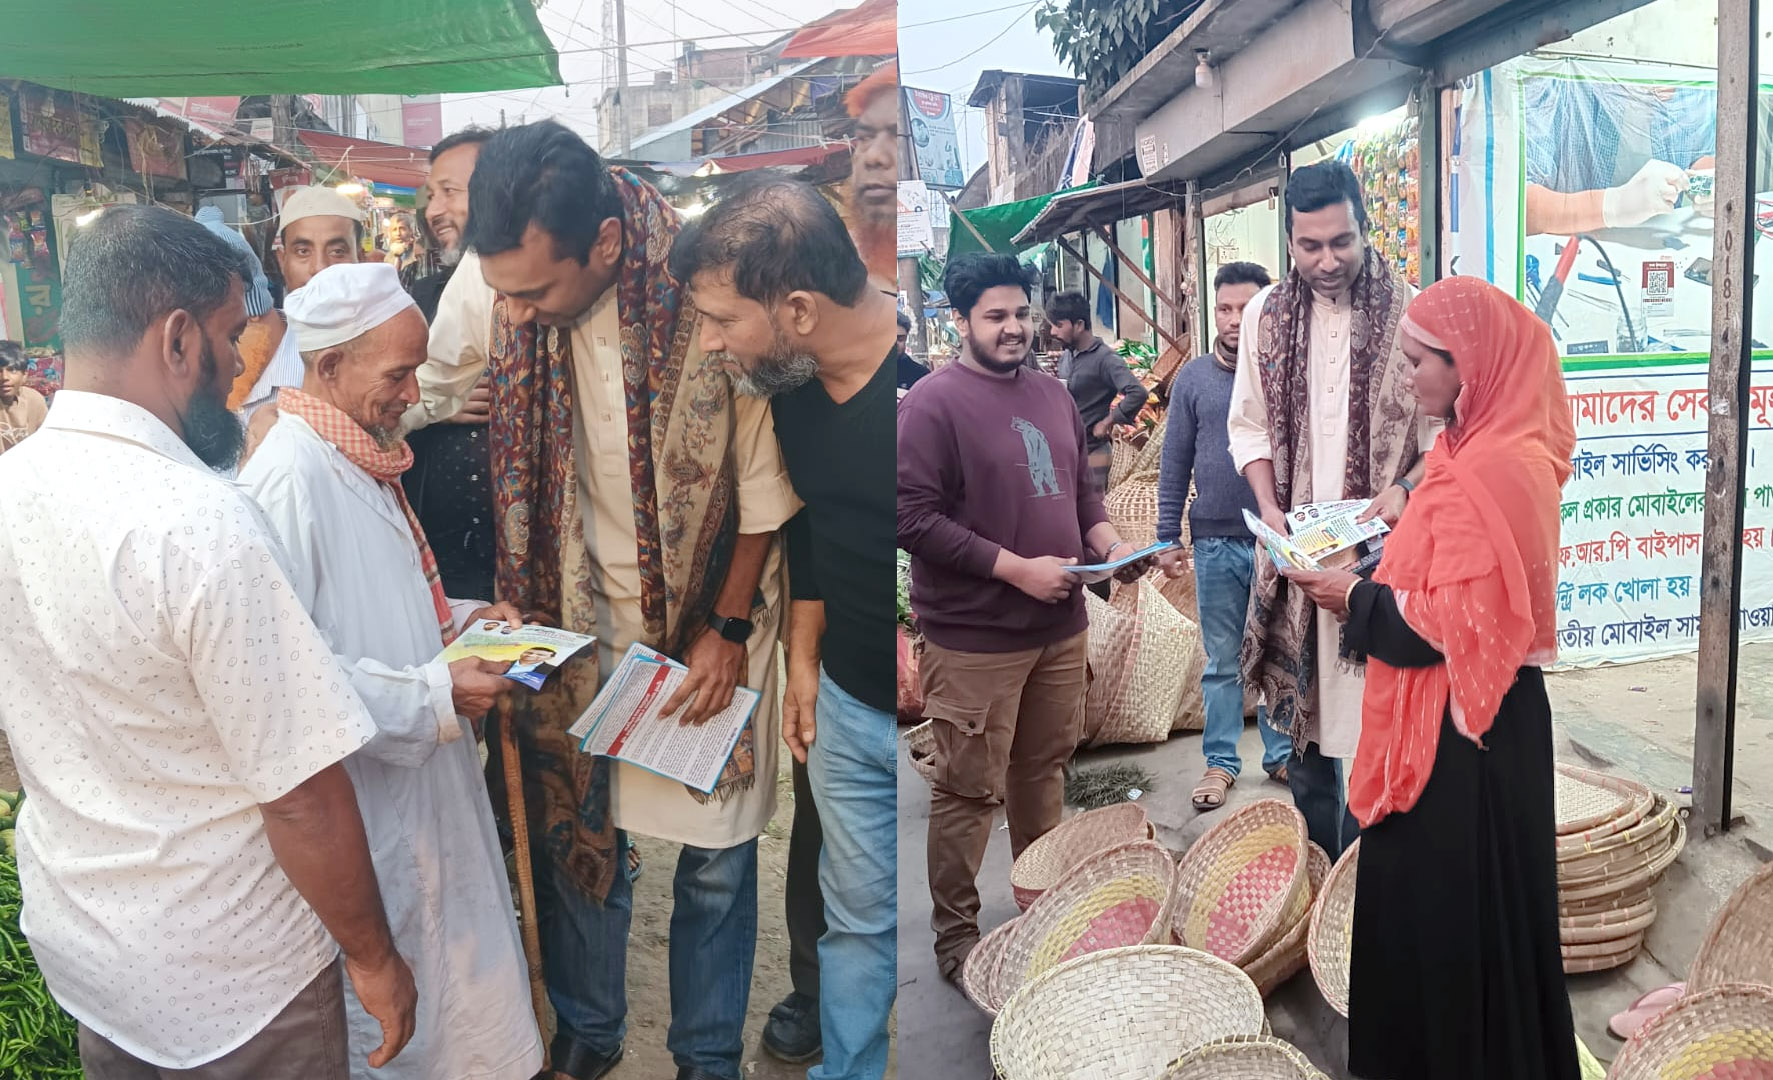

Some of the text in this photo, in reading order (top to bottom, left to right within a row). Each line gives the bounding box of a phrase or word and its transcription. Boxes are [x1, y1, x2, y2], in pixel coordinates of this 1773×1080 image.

[1568, 388, 1659, 427] মাদের
[1570, 448, 1607, 482] াইল
[1611, 443, 1680, 476] সার্ভিসিং
[1560, 501, 1579, 525] কল
[1583, 494, 1623, 523] প্রকার
[1558, 530, 1631, 569] ফ.আর.পি
[1635, 529, 1702, 560] বাইপাস
[1556, 581, 1575, 612] ন্ট্রি
[1578, 582, 1609, 606] লক
[1614, 576, 1661, 603] খোলা
[1666, 575, 1692, 598] হয়
[1557, 619, 1597, 651] তীয়
[1601, 613, 1672, 645] মোবাইল
